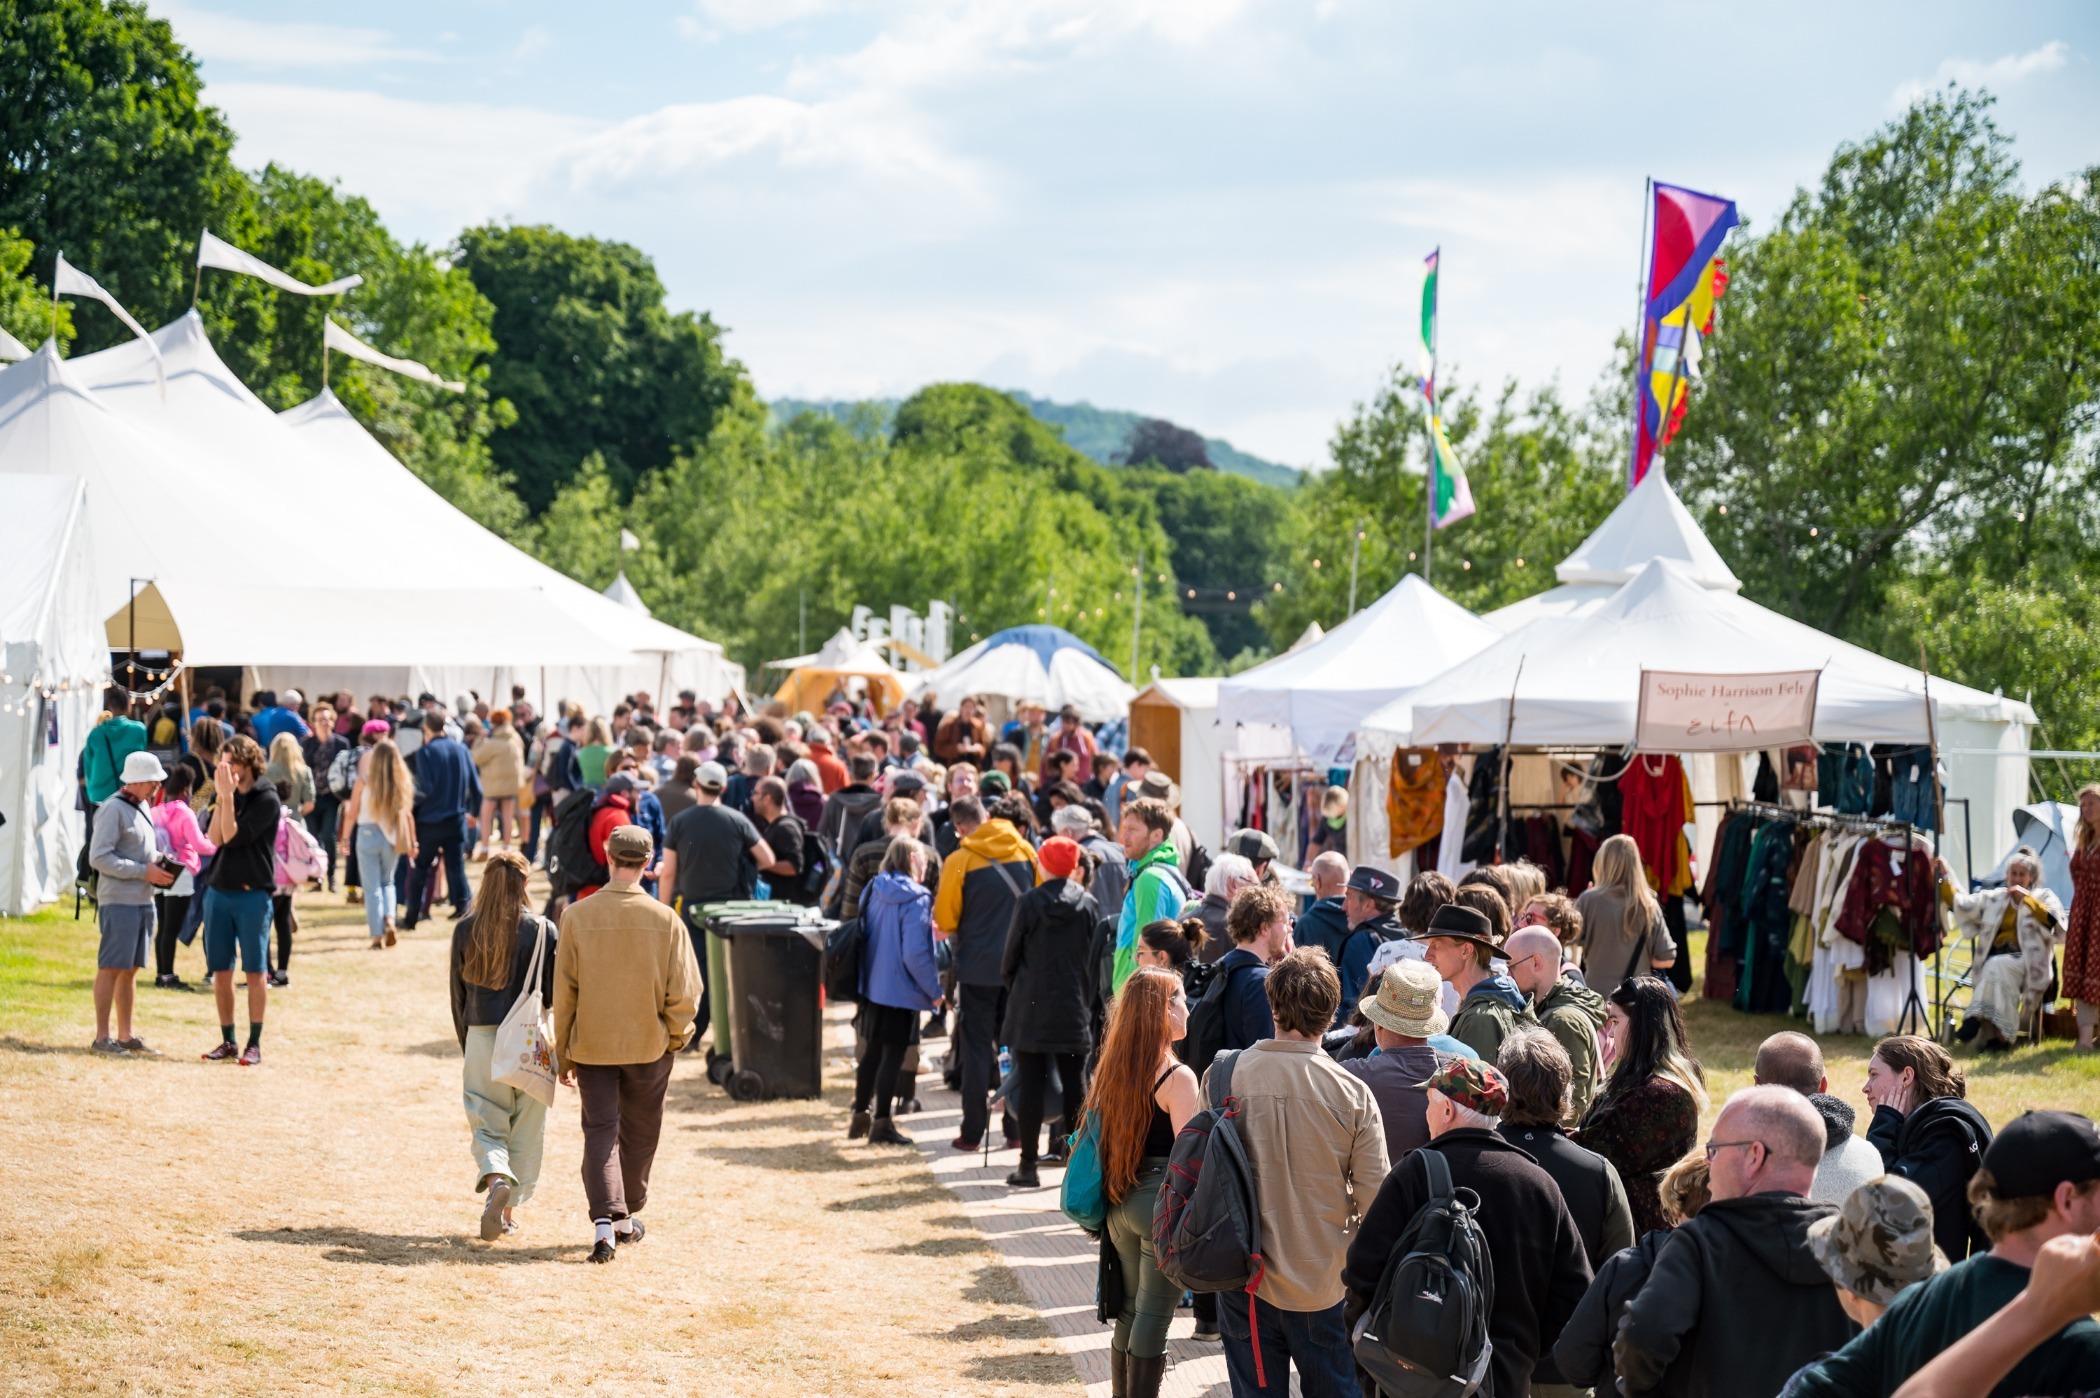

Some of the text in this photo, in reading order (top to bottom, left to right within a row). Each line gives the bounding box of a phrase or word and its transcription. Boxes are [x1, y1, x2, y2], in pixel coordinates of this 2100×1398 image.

[1657, 680, 1804, 700] Sophie Harrison Felt
